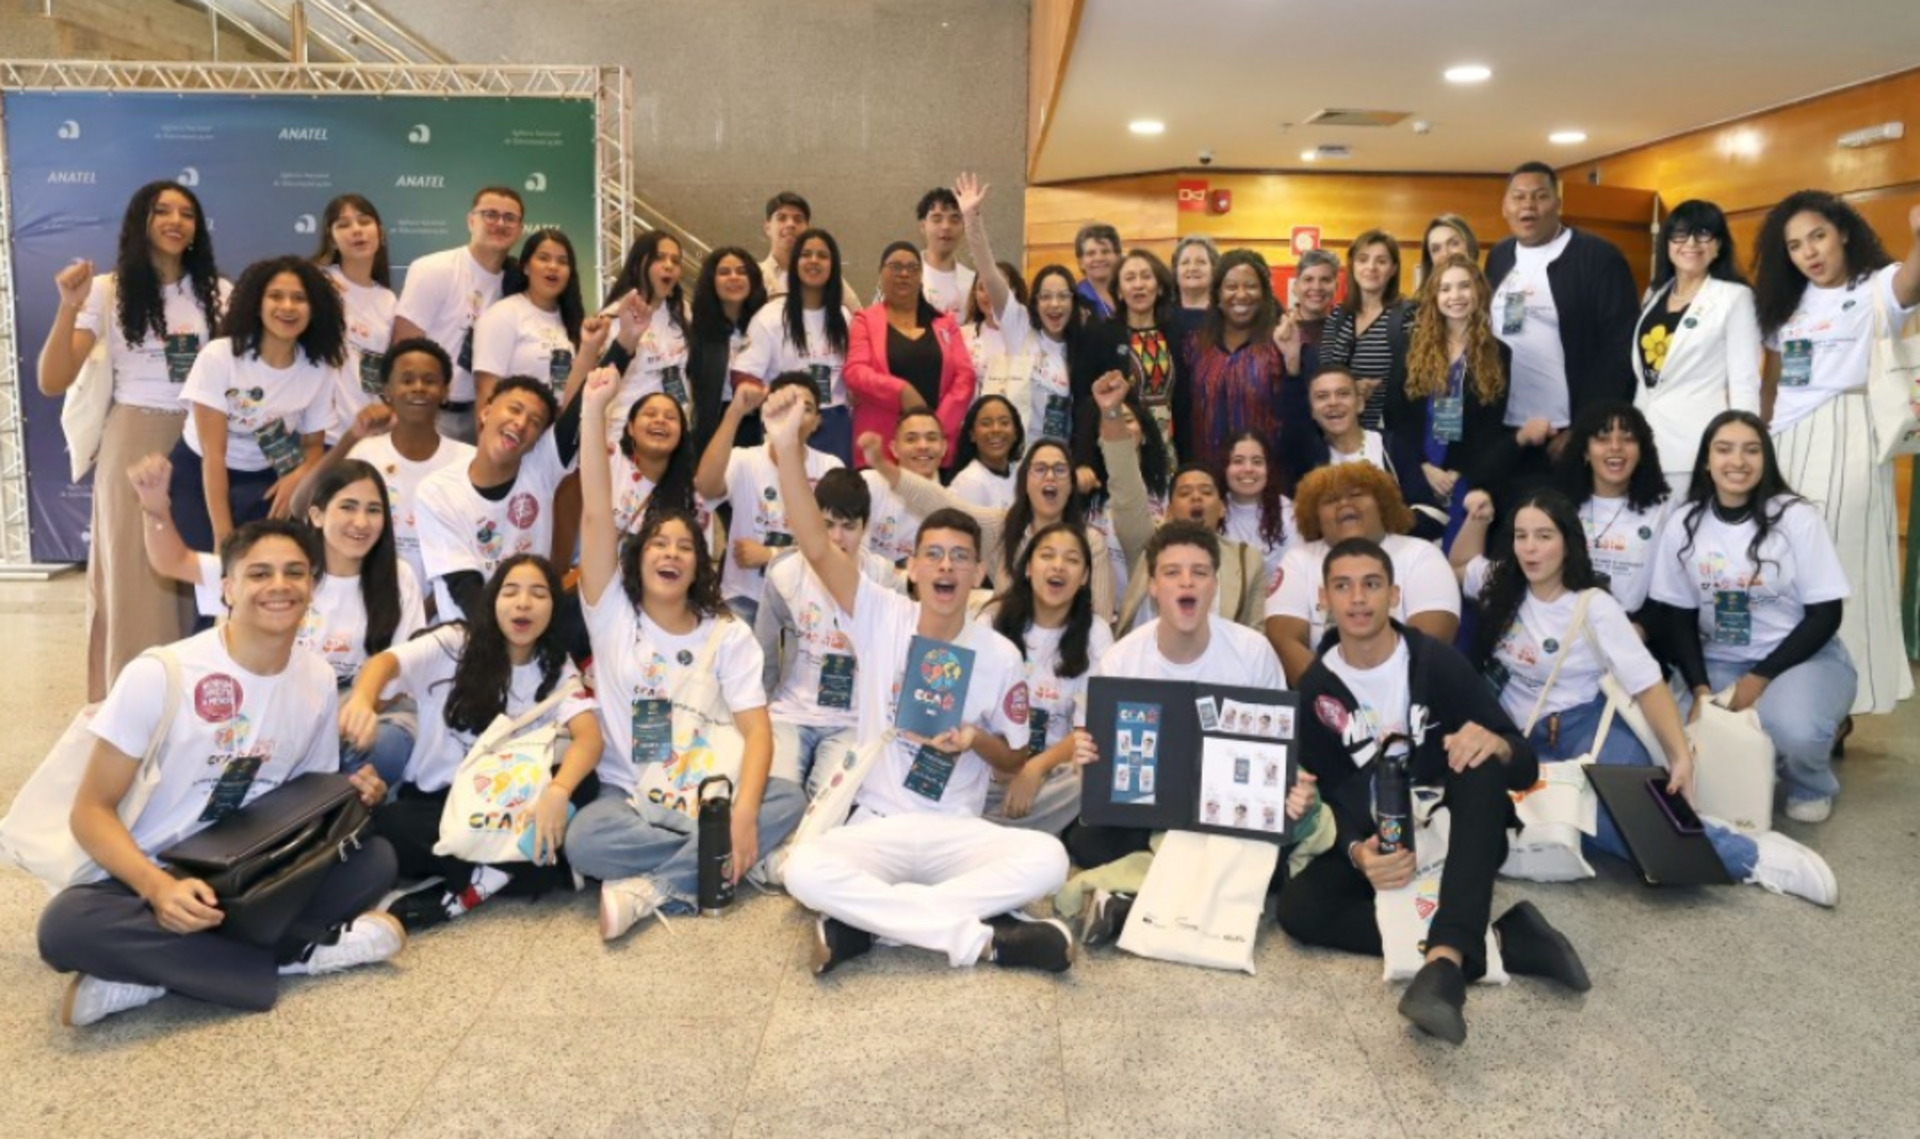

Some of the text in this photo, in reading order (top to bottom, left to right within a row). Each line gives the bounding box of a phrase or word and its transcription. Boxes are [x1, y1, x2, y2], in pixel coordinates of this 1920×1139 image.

[278, 127, 329, 141] ANATEL
[47, 171, 97, 184] ANATEL
[395, 175, 446, 189] ANATEL
